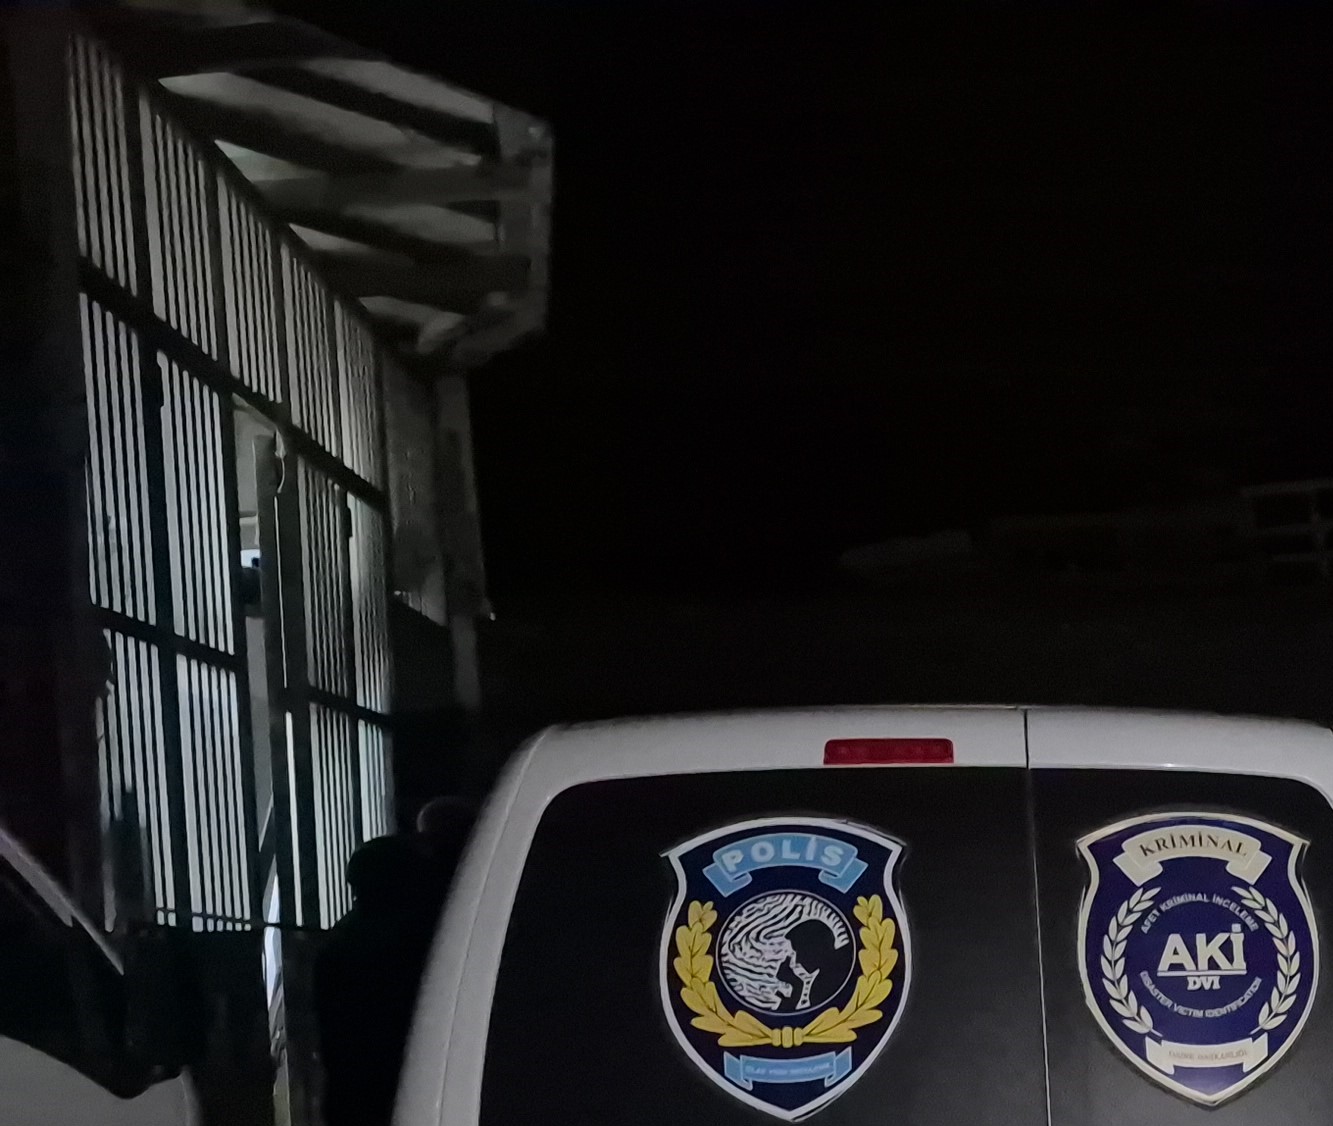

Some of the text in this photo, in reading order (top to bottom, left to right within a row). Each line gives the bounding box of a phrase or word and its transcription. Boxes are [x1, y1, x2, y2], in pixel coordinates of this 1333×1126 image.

[721, 836, 845, 873] POLİS
[1139, 830, 1248, 858] KRİMİNAL
[1158, 922, 1246, 972] AKİ
[1187, 976, 1221, 991] DVI
